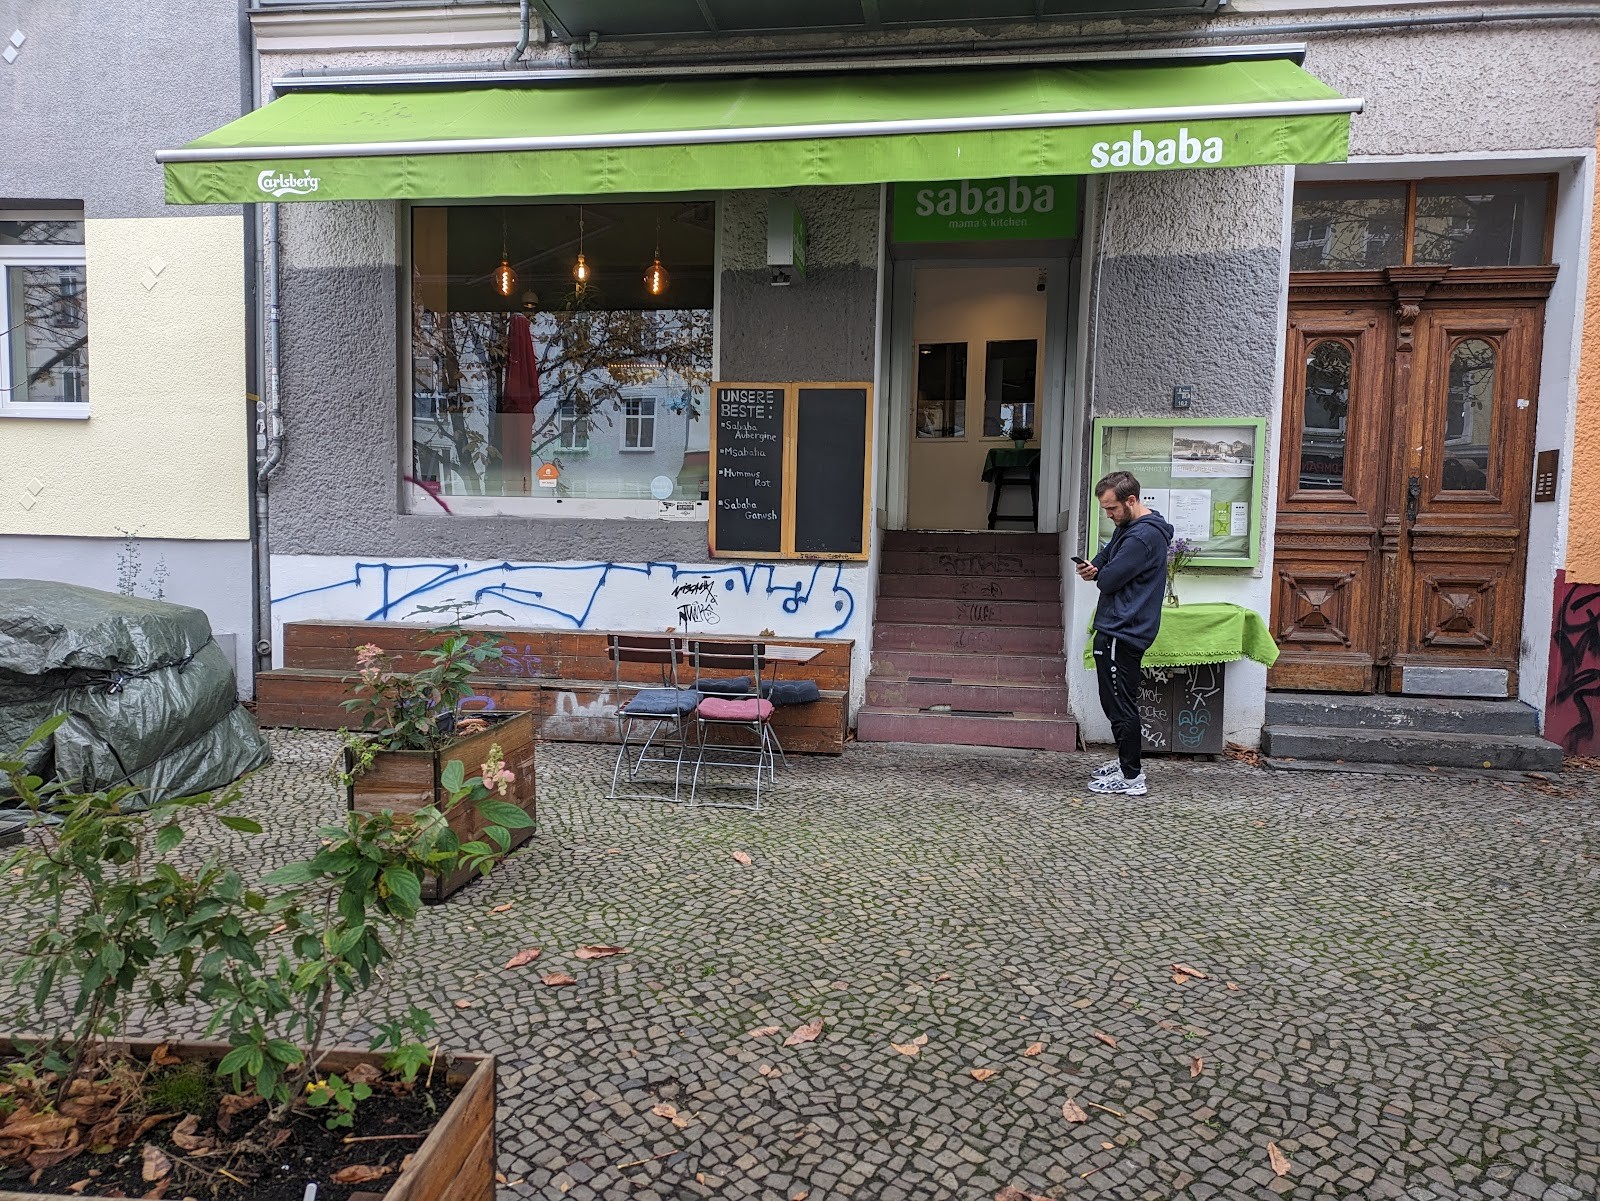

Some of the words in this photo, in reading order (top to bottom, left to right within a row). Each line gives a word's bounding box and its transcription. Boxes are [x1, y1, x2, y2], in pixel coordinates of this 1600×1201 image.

[1090, 128, 1223, 168] sababa
[257, 169, 320, 197] Carlsberg
[915, 177, 1055, 217] sababa
[949, 218, 987, 228] mama's
[990, 217, 1028, 227] kitchen
[721, 390, 774, 404] UNSERE
[734, 430, 777, 442] Aubergine
[724, 468, 760, 478] Hummus
